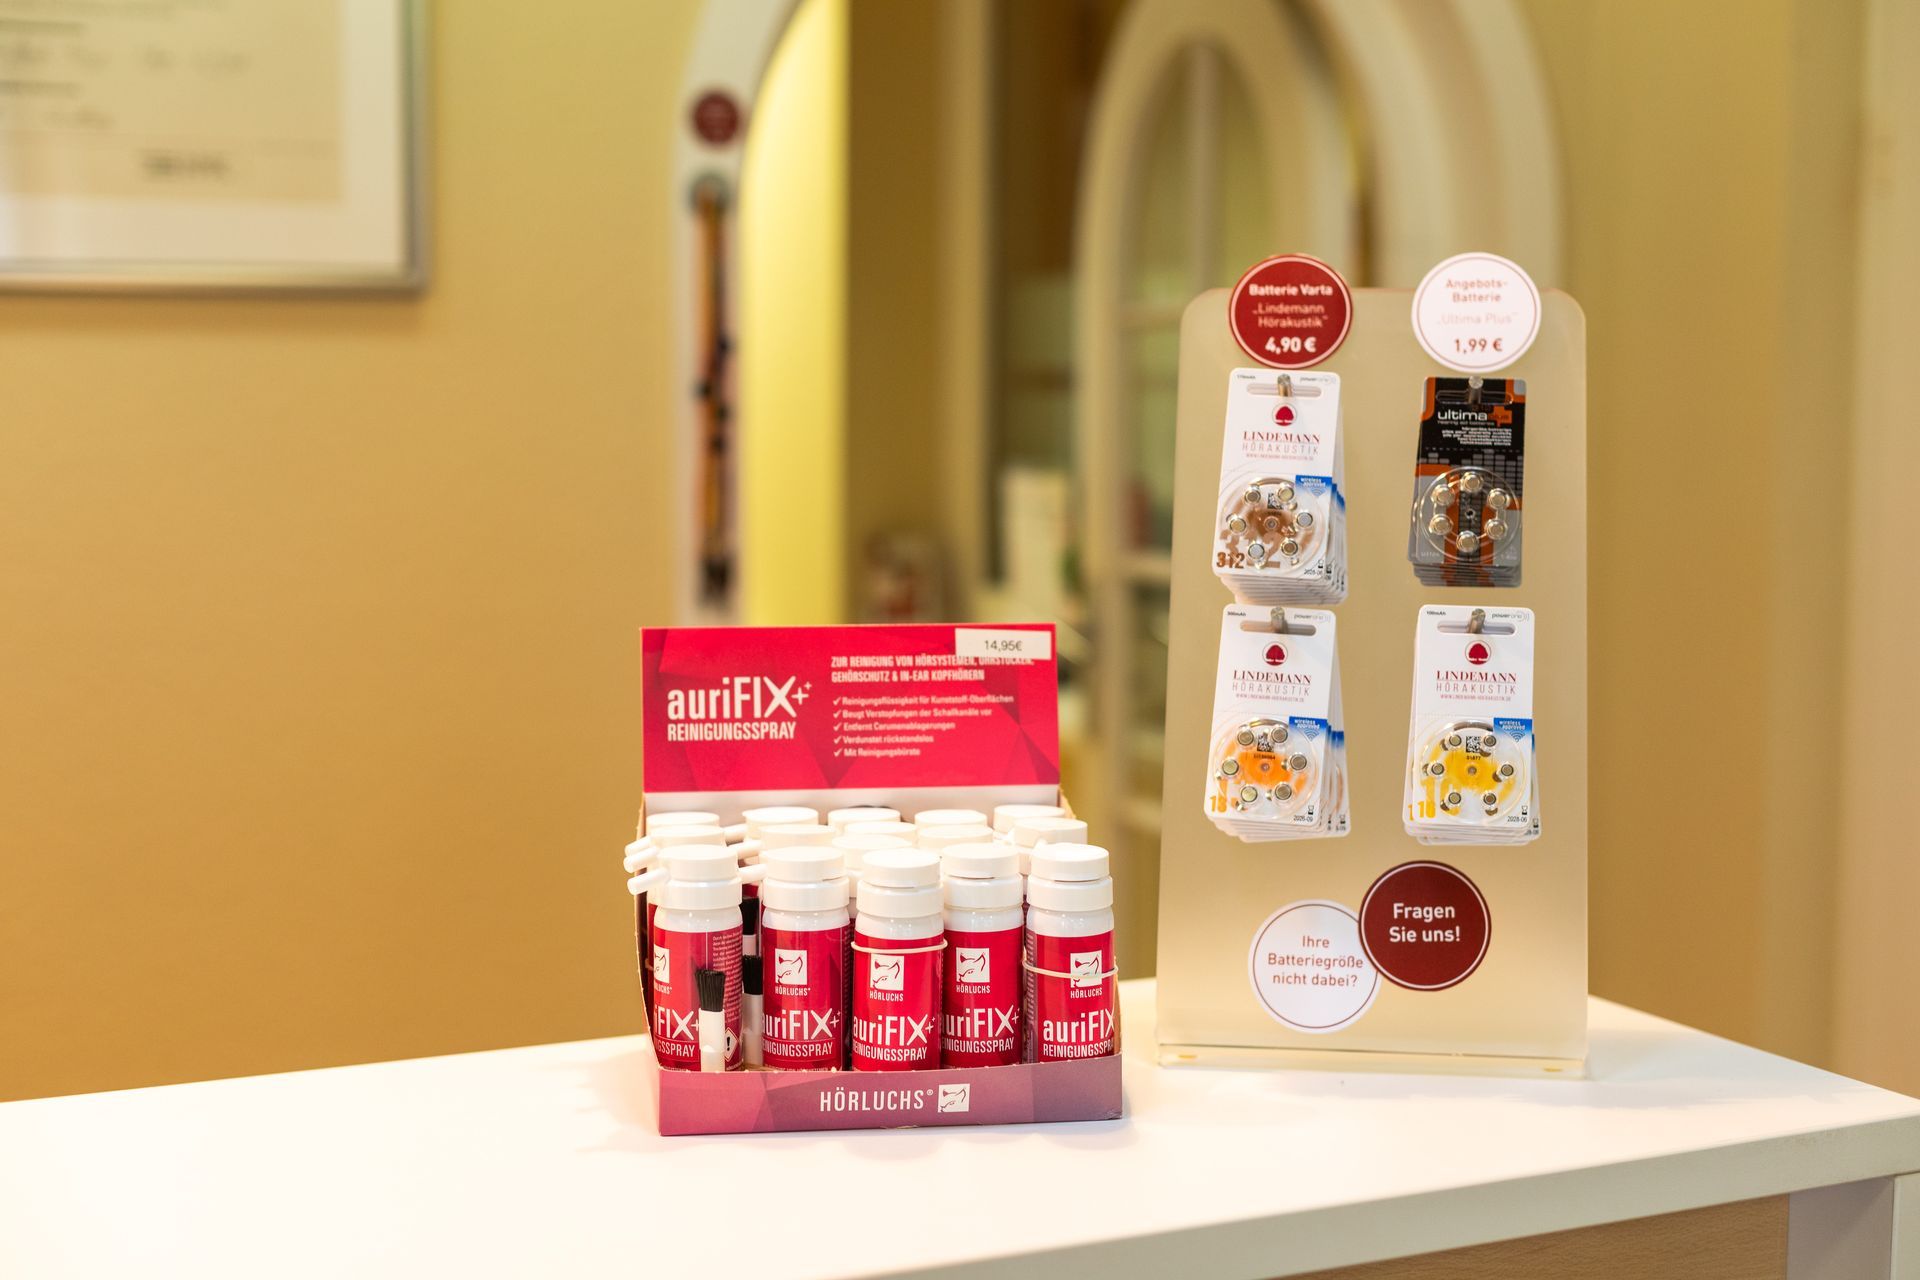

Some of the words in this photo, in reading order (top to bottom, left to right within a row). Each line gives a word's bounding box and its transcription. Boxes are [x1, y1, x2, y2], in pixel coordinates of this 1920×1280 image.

[1249, 283, 1298, 296] Batterie
[1300, 283, 1333, 296] Varta
[1446, 279, 1508, 290] Angebots-
[1452, 292, 1501, 303] Batterie
[1265, 337, 1301, 355] 4,90
[1304, 337, 1317, 353] €
[1455, 337, 1488, 354] 1,99
[1493, 338, 1503, 352] €
[1437, 409, 1488, 421] ultima
[1243, 431, 1320, 443] LINDEMANN
[1242, 441, 1319, 455] HÖRAKUSTIK
[1216, 552, 1245, 569] 312
[985, 641, 1022, 652] 14,95€
[831, 656, 848, 668] ZUR
[849, 656, 894, 667] REINIGUNG
[895, 655, 913, 667] VON
[831, 669, 890, 682] GEHÖRSCHUTZ
[892, 670, 898, 682] &
[900, 670, 930, 682] IN-EAR
[931, 668, 985, 681] KOPFHÖRERN
[1233, 670, 1312, 684] LINDEMANN
[1437, 670, 1517, 683] LINDEMANN
[1232, 681, 1310, 696] HÖRAKUSTIK
[1436, 681, 1516, 695] HÖRAKUSTIK
[919, 709, 932, 717] der
[980, 709, 992, 717] vor
[667, 721, 797, 742] REINIGUNGSSPRAY
[844, 748, 857, 757] Mit
[1392, 902, 1456, 922] Fragen
[1389, 926, 1417, 942] Sie
[1421, 925, 1461, 942] uns!
[1302, 935, 1330, 948] Ihre
[1267, 953, 1364, 970] Batteriegröße
[1272, 973, 1307, 985] nicht
[1311, 974, 1358, 987] dabei?
[956, 983, 991, 994] HÖRLUCHS
[1070, 987, 1103, 999] HÖRLUCHS
[869, 990, 904, 1002] HÖRLUCHS
